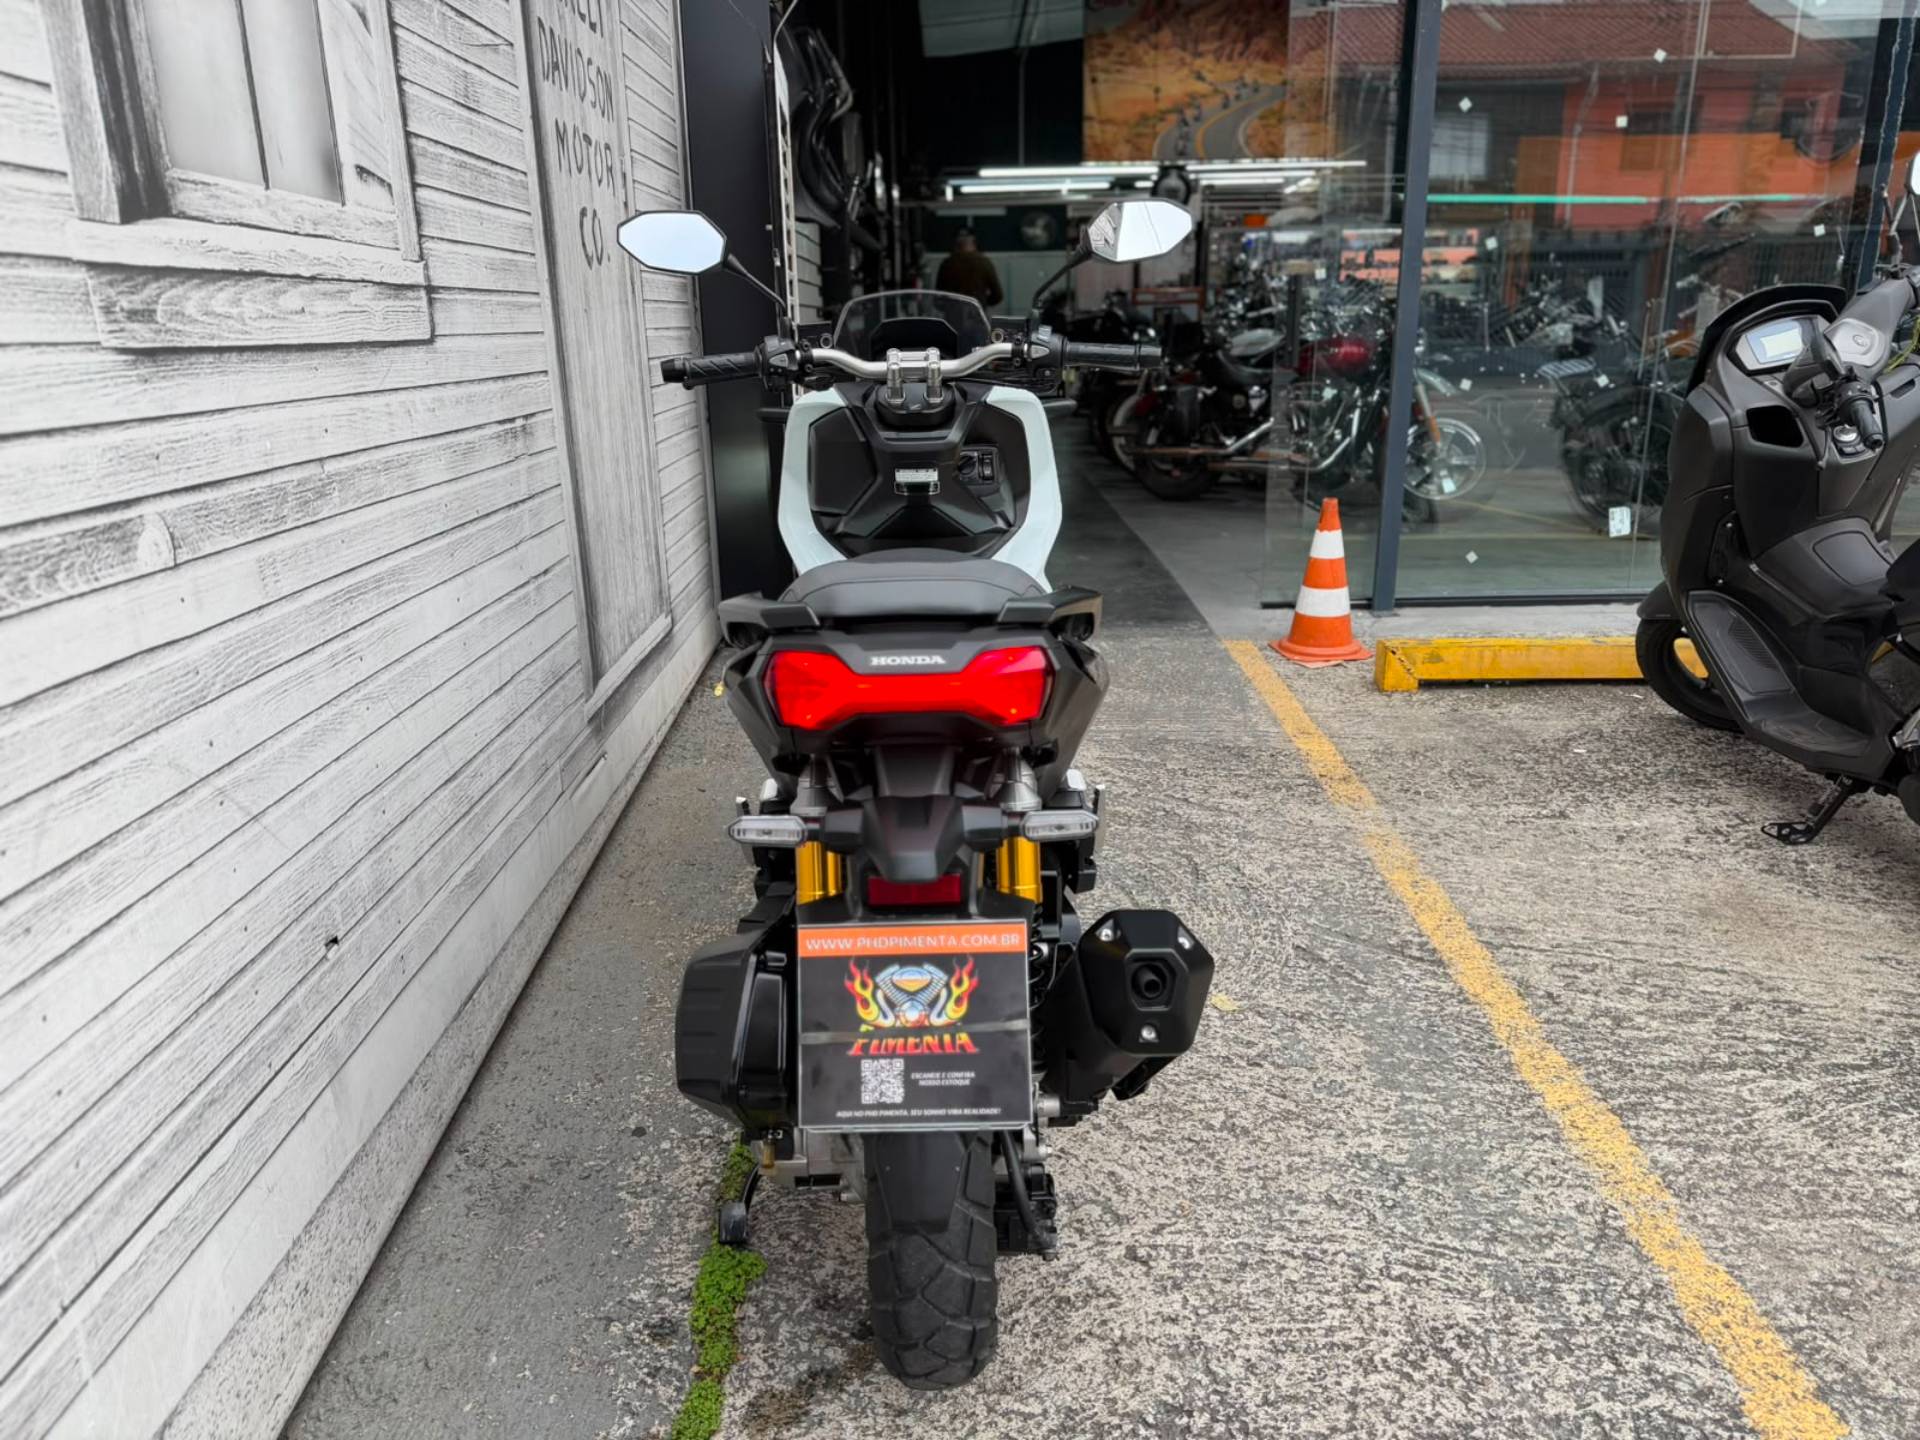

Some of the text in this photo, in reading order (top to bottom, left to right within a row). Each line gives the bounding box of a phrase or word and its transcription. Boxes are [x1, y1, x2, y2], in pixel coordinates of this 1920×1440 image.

[537, 16, 614, 123] DAVIDSON
[555, 117, 616, 197] MOTOR
[579, 206, 611, 270] CO.
[870, 655, 946, 666] HONDA
[836, 1110, 852, 1118] AQUI
